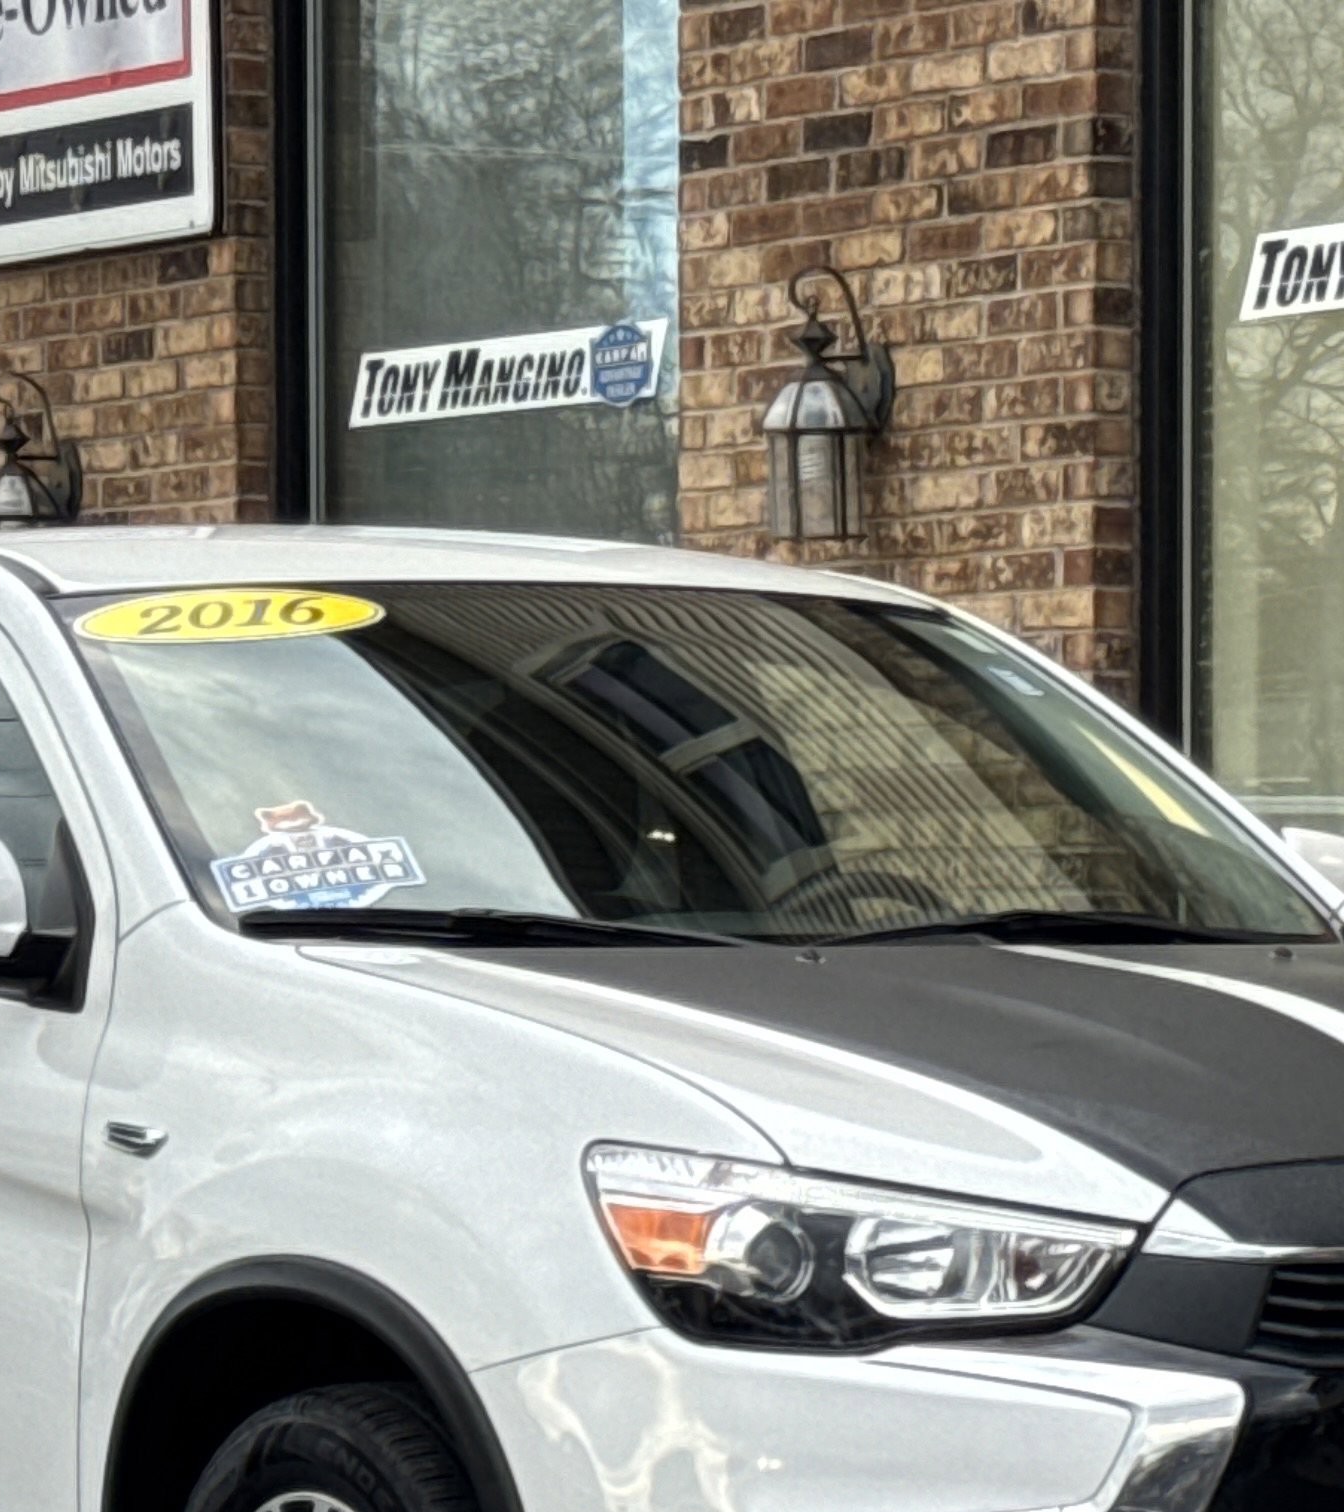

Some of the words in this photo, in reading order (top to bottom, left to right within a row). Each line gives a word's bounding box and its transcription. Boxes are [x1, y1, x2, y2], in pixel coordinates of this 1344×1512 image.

[19, 138, 112, 196] Mitsubishi
[116, 136, 182, 179] Motors
[360, 358, 442, 419] TONY
[137, 596, 325, 636] 2016
[230, 846, 403, 880] CARFAX
[269, 862, 405, 894] OWNER
